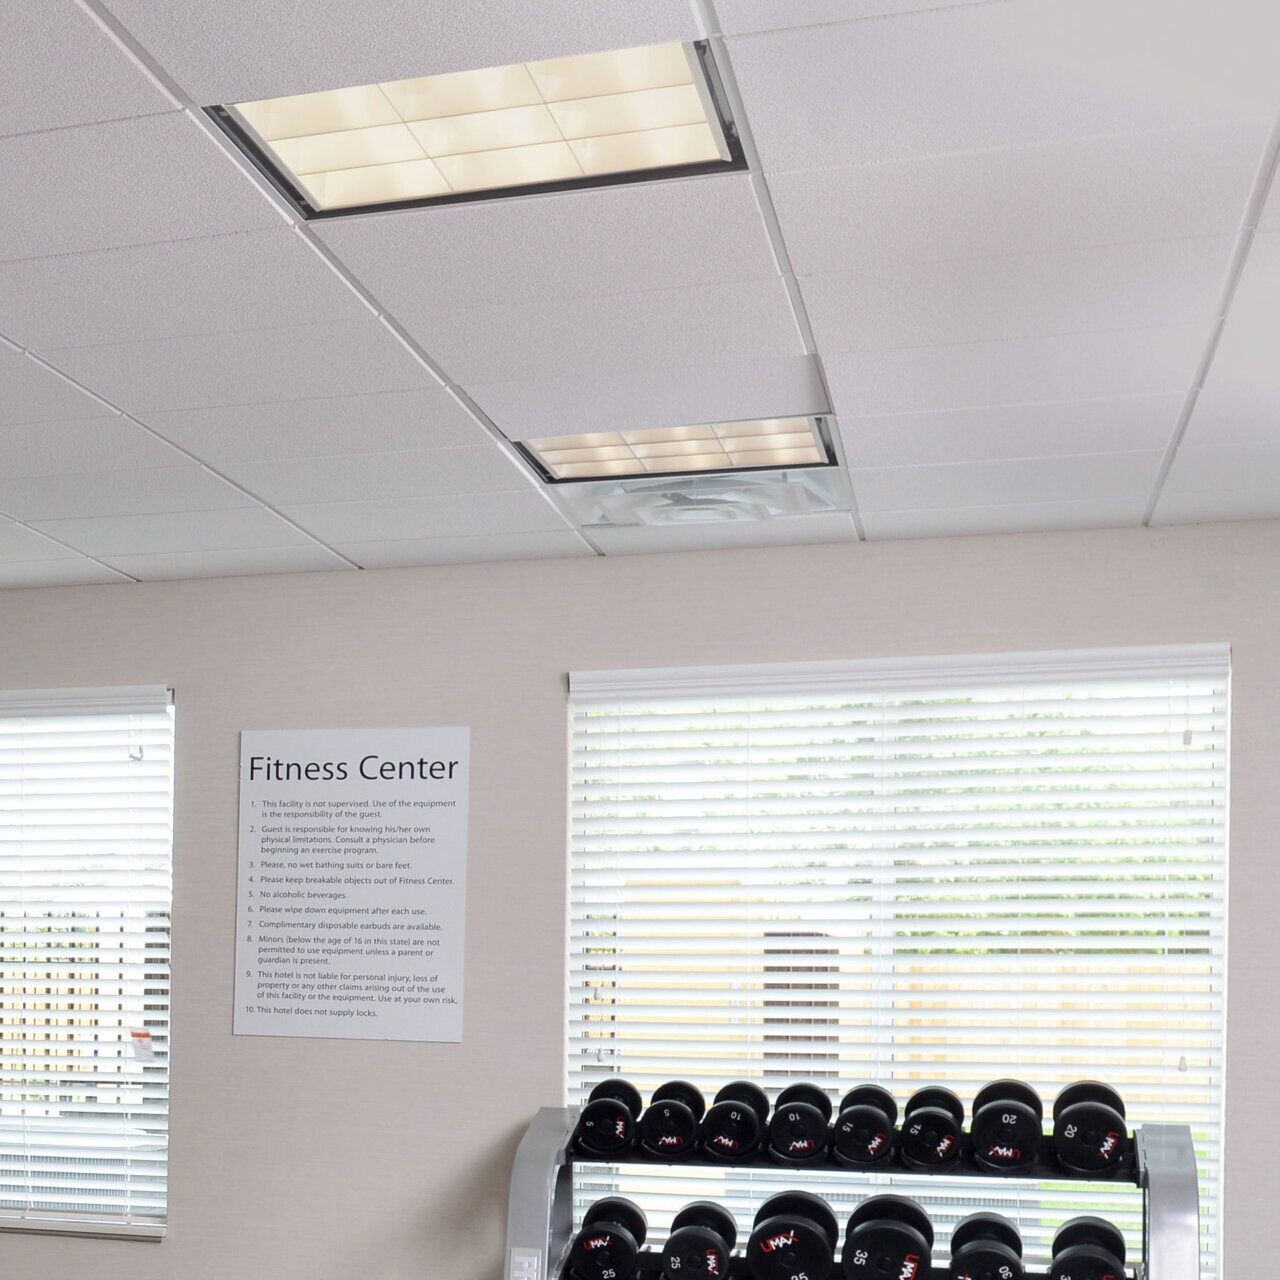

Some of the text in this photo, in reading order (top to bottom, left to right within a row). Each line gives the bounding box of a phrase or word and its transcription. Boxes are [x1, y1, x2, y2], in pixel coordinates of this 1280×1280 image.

[250, 756, 458, 780] Fitness Center
[279, 800, 304, 809] facility
[413, 800, 456, 808] equipment
[269, 810, 282, 818] the
[283, 810, 334, 820] responsibility
[292, 825, 336, 834] responsible
[349, 826, 383, 834] knowing
[261, 836, 291, 844] physical
[335, 836, 364, 844] Consult
[372, 836, 408, 845] physician
[261, 846, 299, 855] beginning
[315, 861, 345, 870] bathing
[376, 861, 394, 869] bare
[285, 876, 304, 885] keep
[305, 876, 343, 884] breakable
[344, 876, 372, 886] objects
[399, 877, 426, 885] Fitness
[272, 891, 306, 899] alcoholic
[259, 905, 283, 913] Please
[284, 906, 303, 914] wipe
[304, 906, 326, 914] down
[328, 907, 370, 916] equipment
[371, 907, 390, 915] after
[391, 907, 410, 915] each
[259, 920, 317, 930] Complimentary
[318, 921, 359, 931] disposable
[360, 922, 391, 930] earbuds
[258, 935, 284, 943] Minors
[285, 936, 312, 944] (below
[313, 936, 326, 944] the
[327, 938, 342, 946] age
[354, 937, 363, 945] 16
[373, 937, 388, 945] this
[258, 945, 295, 955] permitted
[321, 948, 364, 956] equipment
[365, 948, 389, 956] unless
[257, 956, 291, 965] guardian
[257, 970, 273, 978] This
[274, 971, 294, 979] hotel
[318, 972, 339, 980] liable
[340, 972, 352, 980] for
[353, 973, 386, 982] personal
[413, 974, 428, 982] loss
[257, 982, 290, 991] property
[301, 983, 316, 991] any
[317, 983, 338, 991] other
[338, 983, 363, 991] claims
[364, 984, 390, 994] arising
[417, 985, 430, 993] the
[266, 991, 280, 999] this
[281, 992, 306, 1001] facility
[318, 993, 331, 1001] the
[403, 997, 421, 1005] your
[256, 1006, 272, 1014] This
[273, 1006, 293, 1014] hotel
[294, 1007, 313, 1015] does
[329, 1008, 355, 1018] supply
[730, 1111, 740, 1120] 10
[789, 1113, 800, 1122] 10
[1002, 1113, 1017, 1124] 20
[842, 1122, 853, 1133] 15
[910, 1123, 922, 1135] 15
[1064, 1124, 1078, 1139] 20
[583, 1235, 613, 1250] UMAX
[760, 1230, 800, 1253] UMAX
[671, 1257, 681, 1269] 25
[706, 1248, 719, 1276] UMAX
[854, 1249, 868, 1266] 35
[602, 1269, 616, 1279] 25
[999, 1266, 1013, 1279] 30
